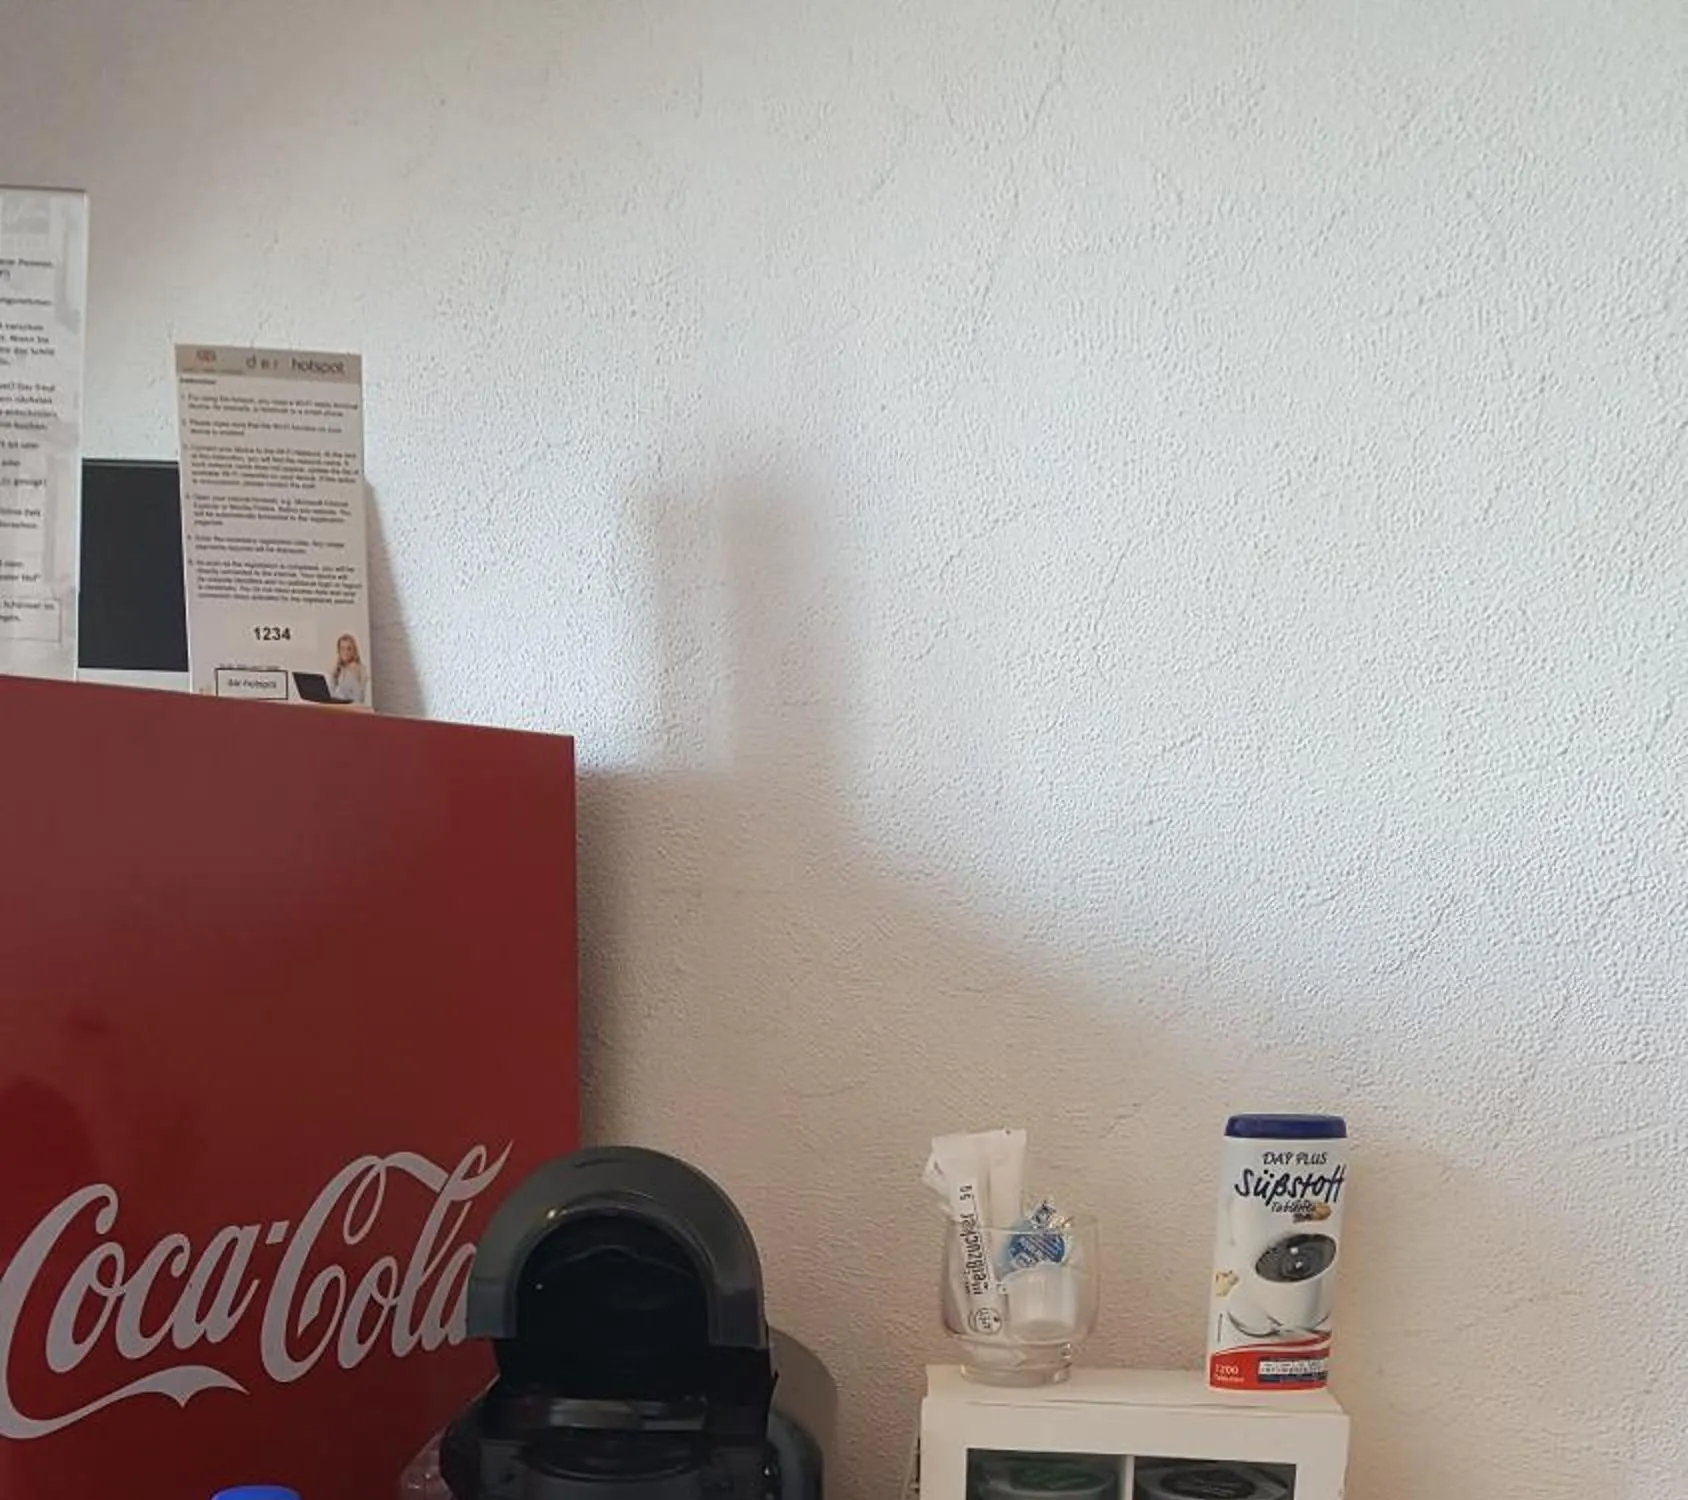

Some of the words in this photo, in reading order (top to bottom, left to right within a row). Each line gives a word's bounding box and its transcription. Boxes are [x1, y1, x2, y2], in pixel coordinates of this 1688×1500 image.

[253, 626, 291, 641] 1234
[1234, 1163, 1347, 1206] Süßstoff
[0, 1140, 514, 1439] Coca-Cola
